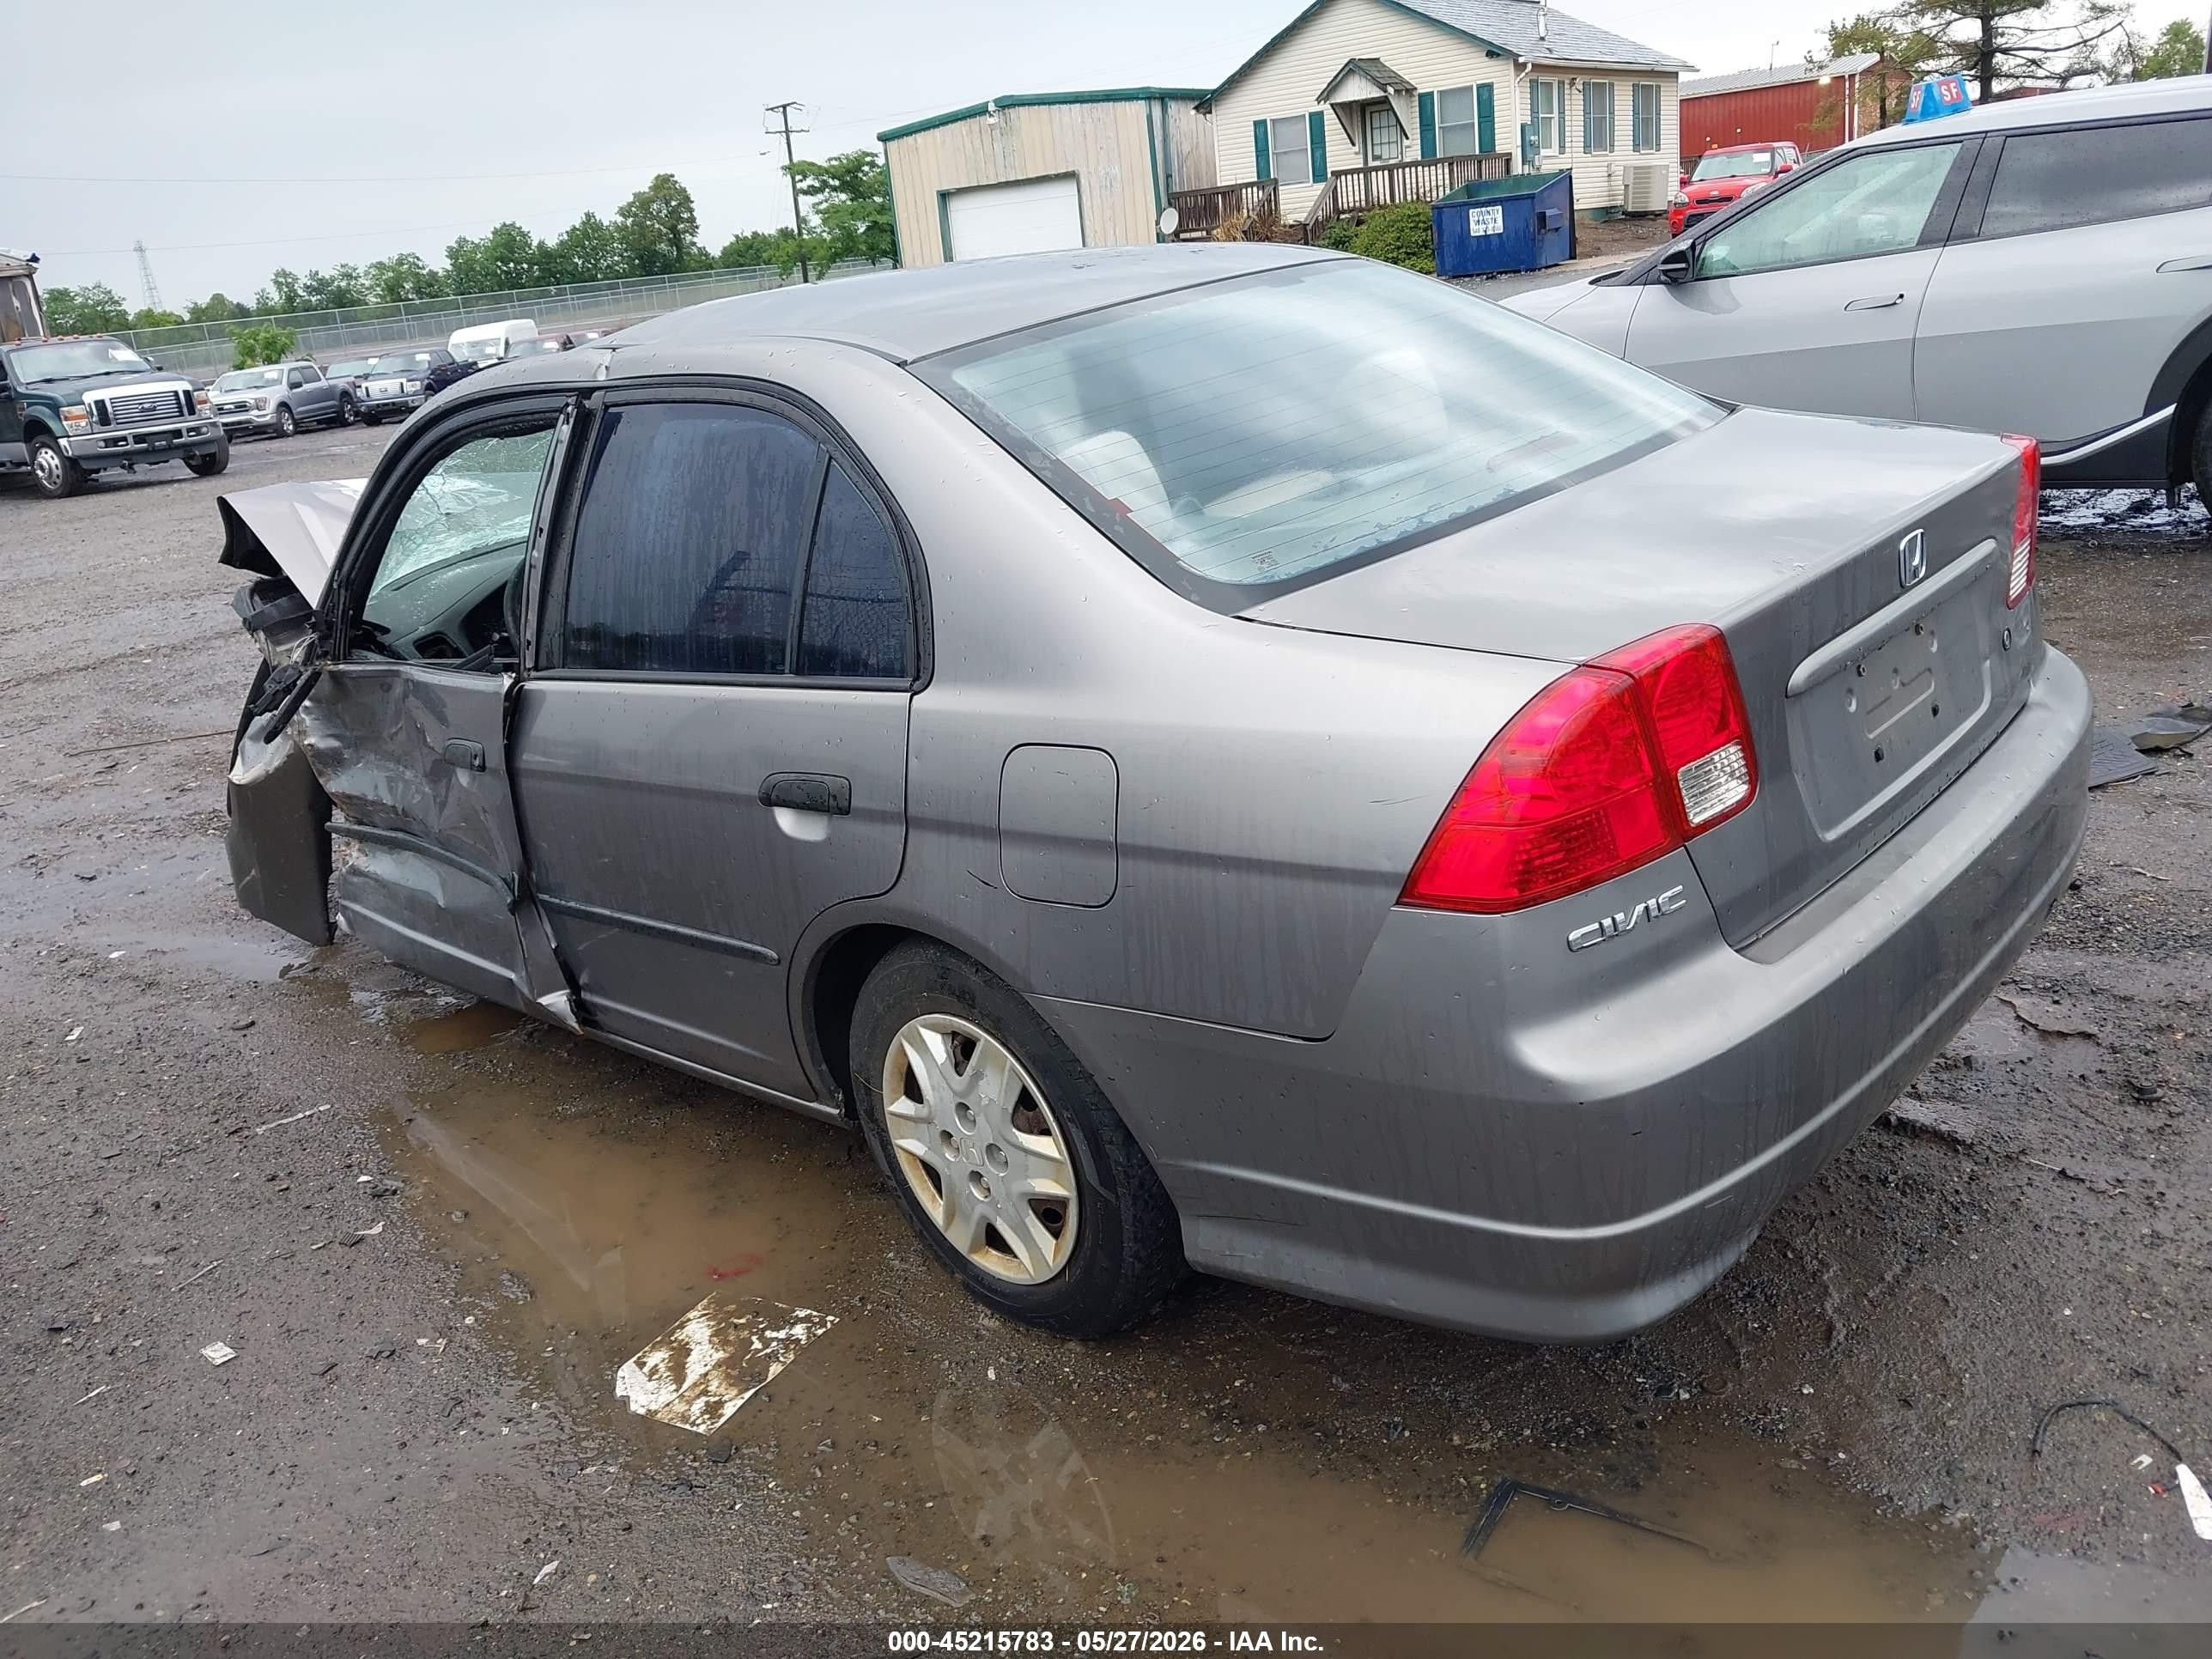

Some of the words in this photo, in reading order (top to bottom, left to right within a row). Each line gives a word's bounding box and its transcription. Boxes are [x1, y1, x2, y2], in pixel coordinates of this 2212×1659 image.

[1911, 90, 1921, 110] SF
[1941, 82, 1959, 101] SF
[1471, 208, 1499, 218] COUNTY
[1474, 217, 1498, 226] WASTE
[1567, 884, 1686, 952] CIVIC
